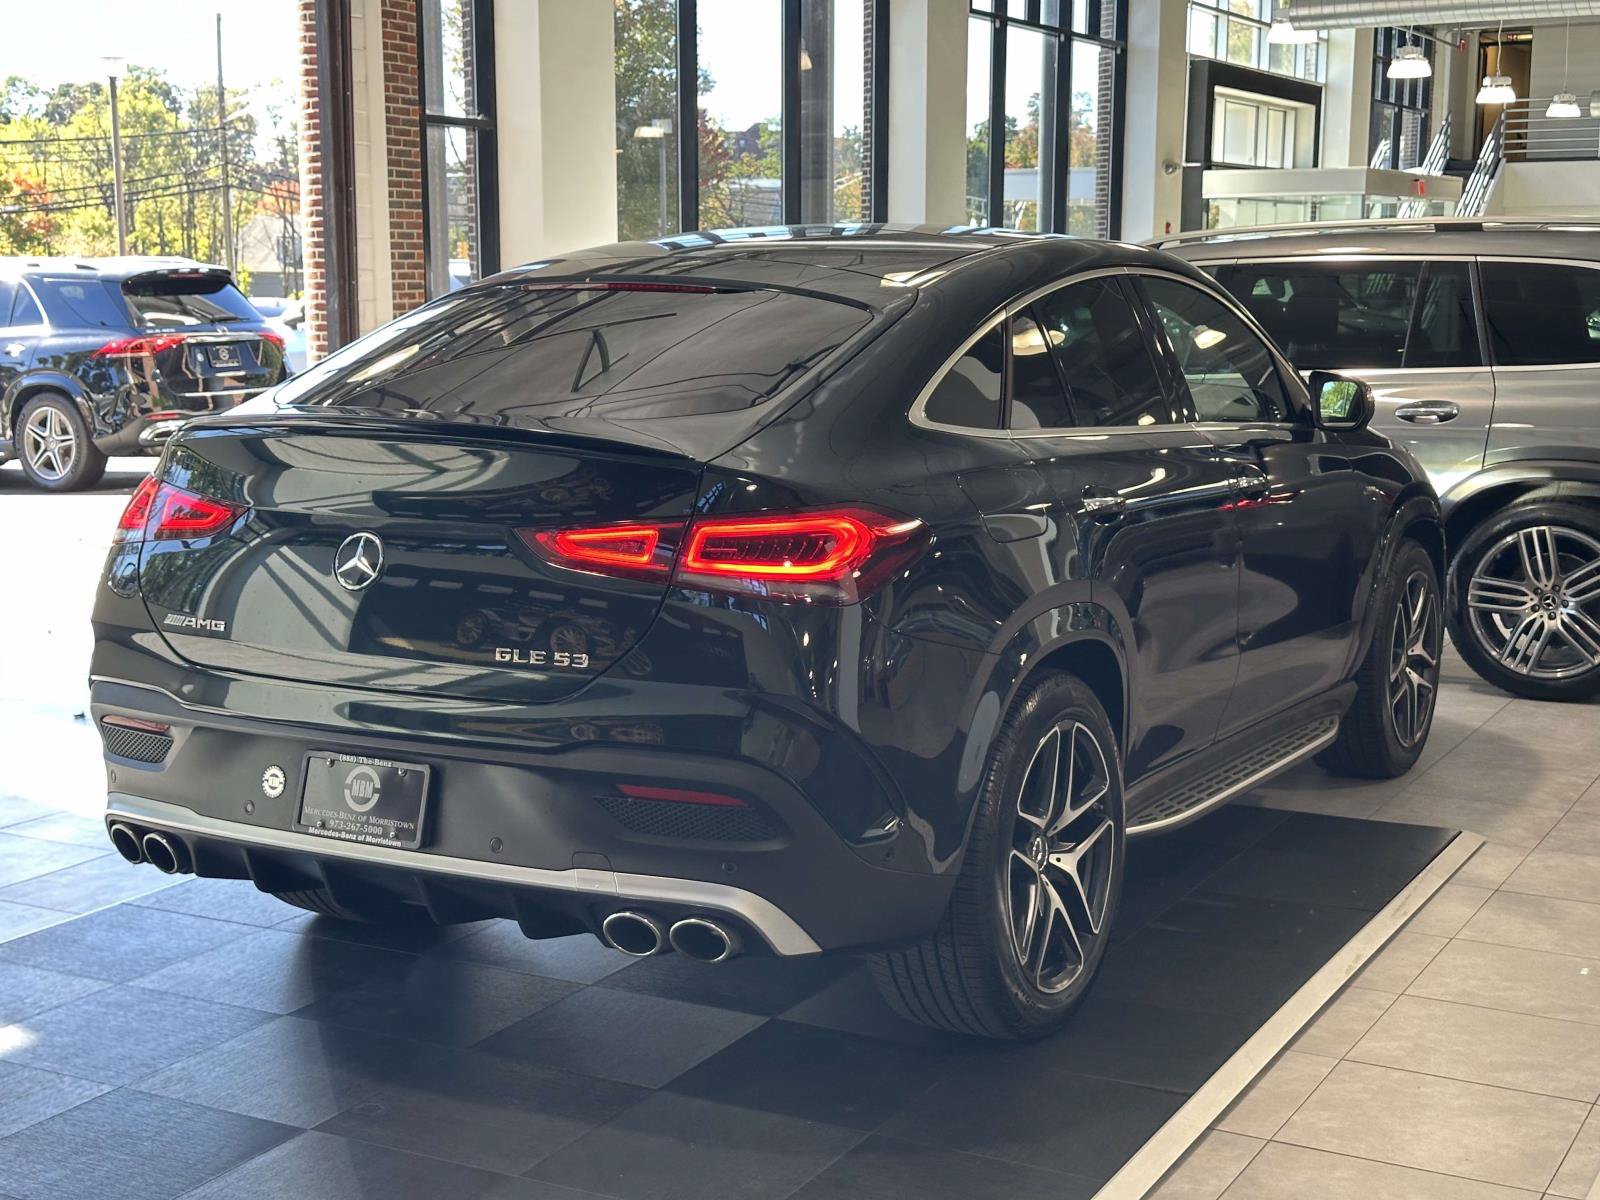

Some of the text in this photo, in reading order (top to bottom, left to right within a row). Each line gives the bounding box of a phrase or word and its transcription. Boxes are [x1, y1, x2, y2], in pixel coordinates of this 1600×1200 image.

[182, 616, 225, 631] AMG
[495, 647, 589, 668] GLE 53
[351, 779, 374, 799] MBM
[329, 819, 383, 834] 973-267-5000
[308, 827, 402, 847] Mercedes-Benz of Morristown
